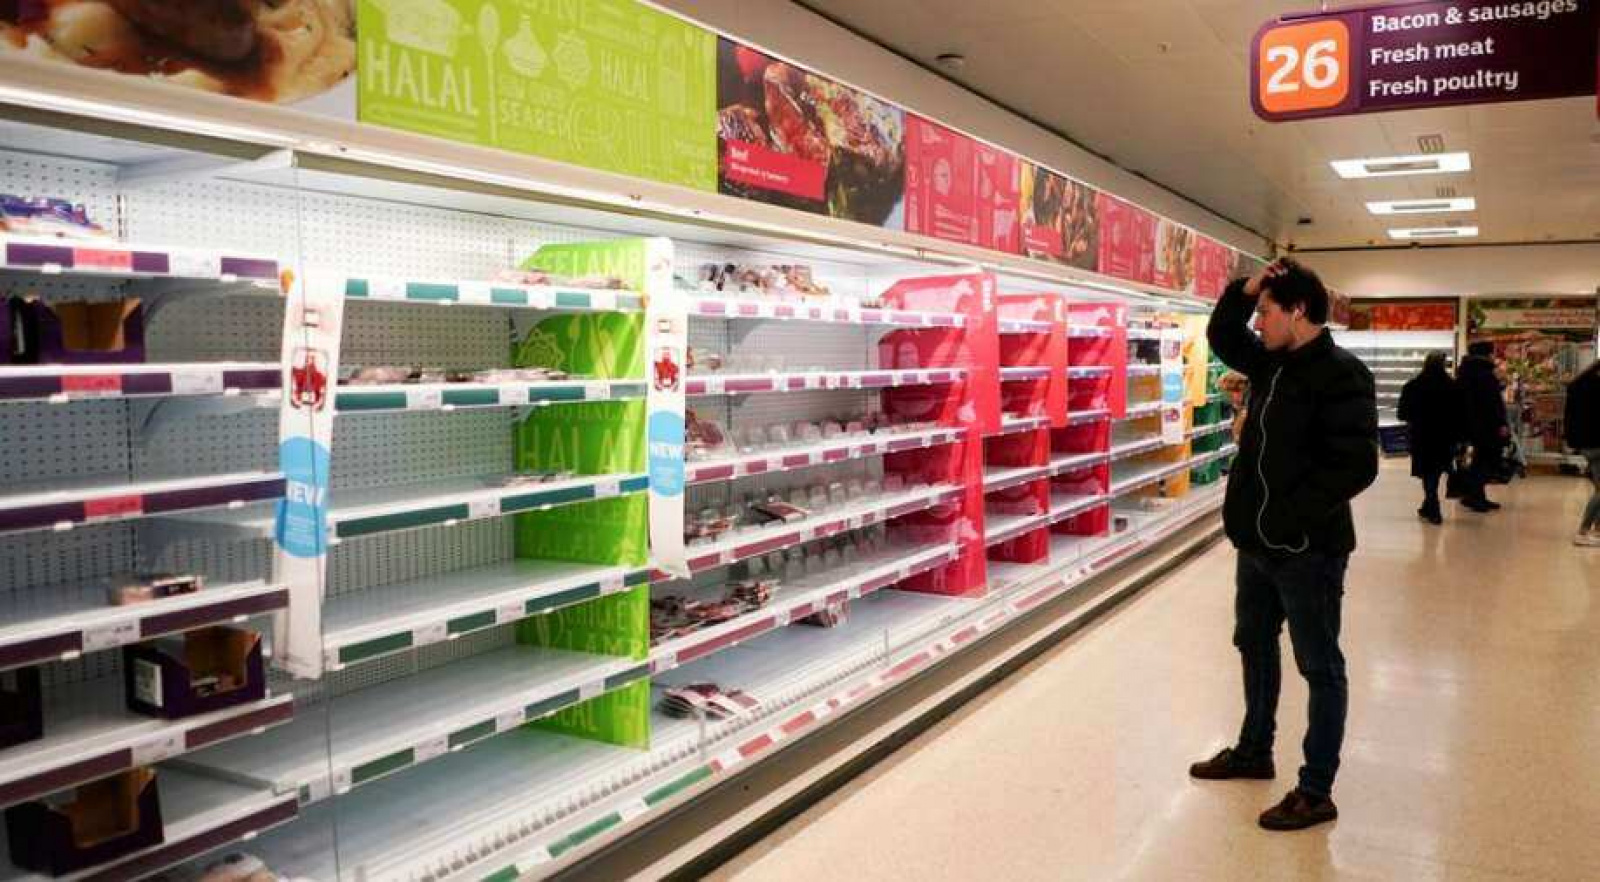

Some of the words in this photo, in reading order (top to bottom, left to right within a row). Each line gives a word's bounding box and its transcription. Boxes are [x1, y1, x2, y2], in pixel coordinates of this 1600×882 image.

[1371, 12, 1440, 33] Bacon
[1444, 6, 1463, 25] &
[1467, 0, 1578, 23] sausages
[1265, 38, 1341, 94] 26
[1370, 42, 1430, 65] Fresh
[1434, 37, 1495, 58] meat
[366, 38, 479, 116] HALAL
[600, 48, 650, 103] HALAL
[1368, 74, 1429, 97] Fresh
[1433, 70, 1519, 96] poultry
